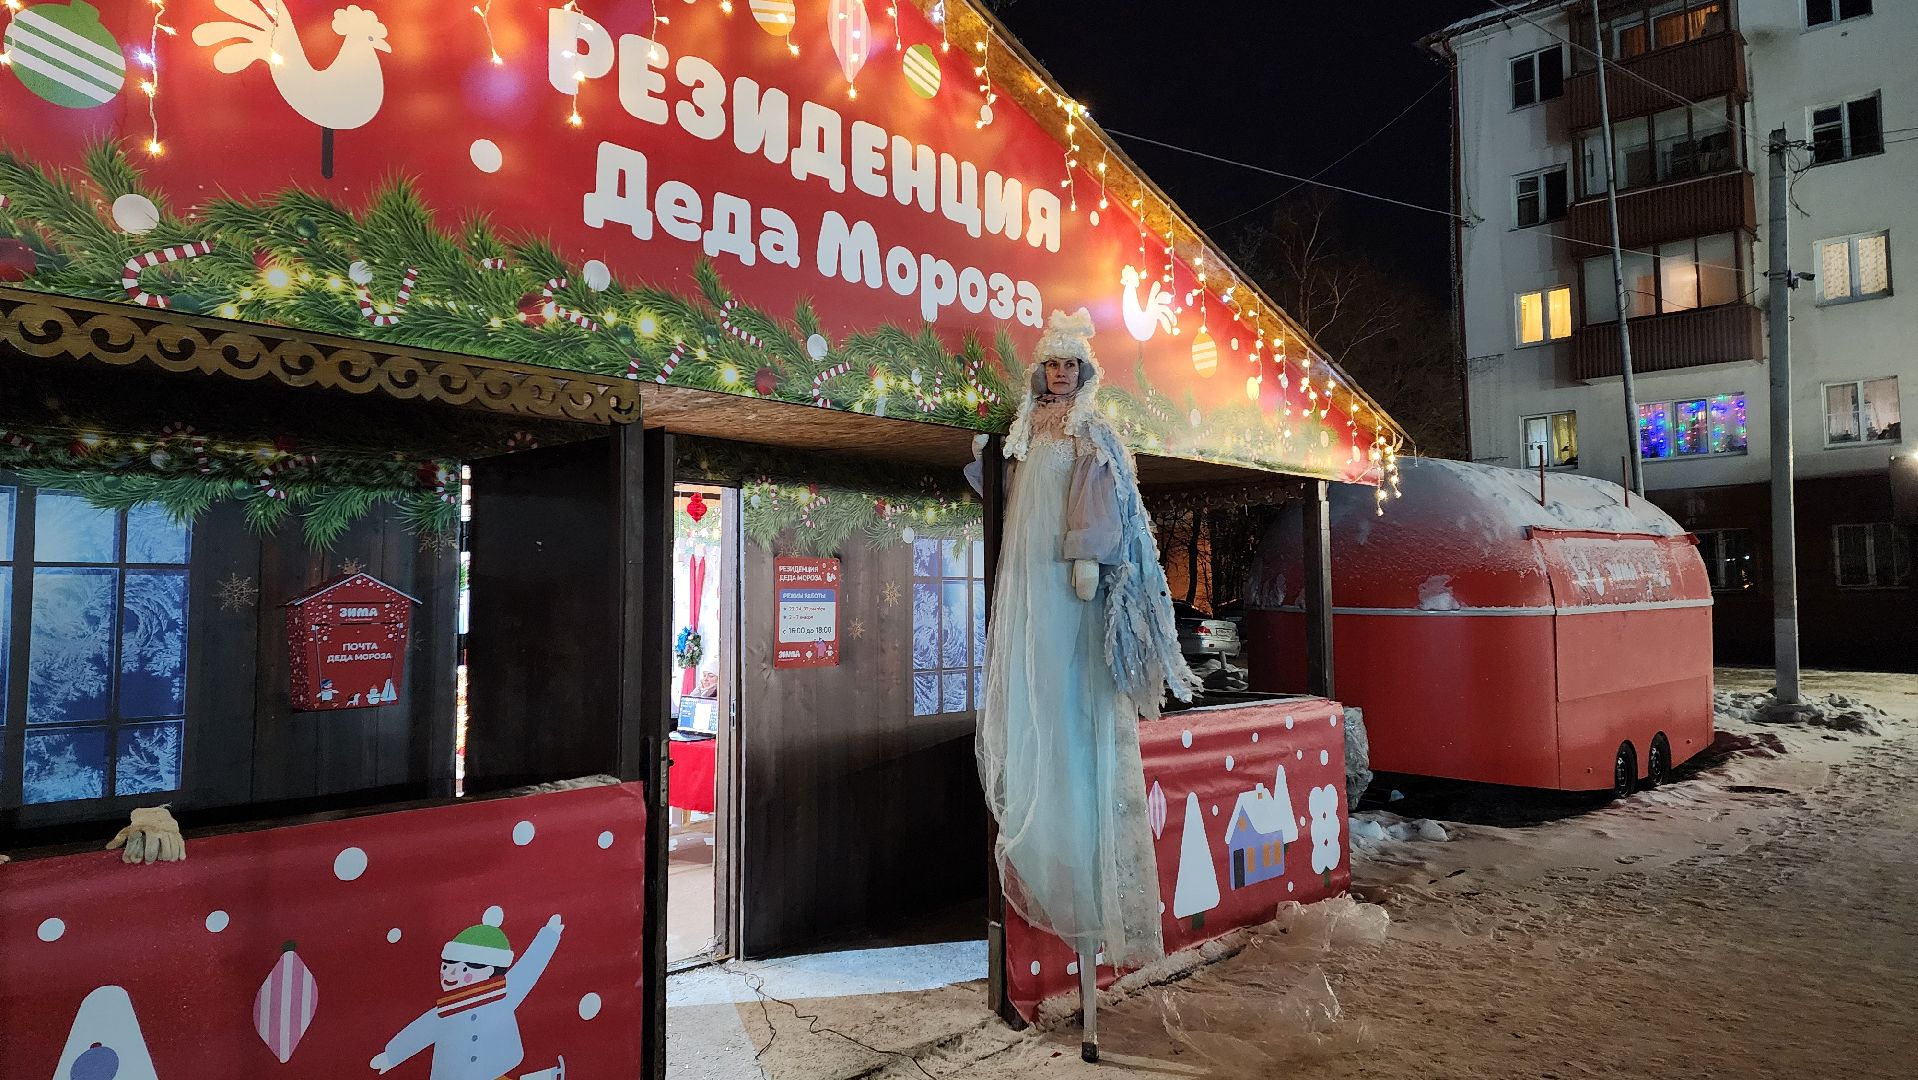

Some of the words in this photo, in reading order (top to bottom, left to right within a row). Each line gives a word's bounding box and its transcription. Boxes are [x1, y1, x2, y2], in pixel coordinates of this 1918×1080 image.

[548, 7, 1061, 253] РЕЗИДЕНЦИЯ
[584, 141, 800, 268] Деда
[816, 210, 1044, 328] Мороза
[779, 565, 819, 574] РЕЗИДЕНЦИЯ
[779, 574, 796, 582] ДЕДА
[797, 574, 822, 582] МОРОЗА
[339, 607, 378, 618] ЗИМА
[342, 642, 379, 651] ПОЧТА
[327, 654, 353, 663] ДЕДА
[355, 652, 392, 661] МОРОЗА
